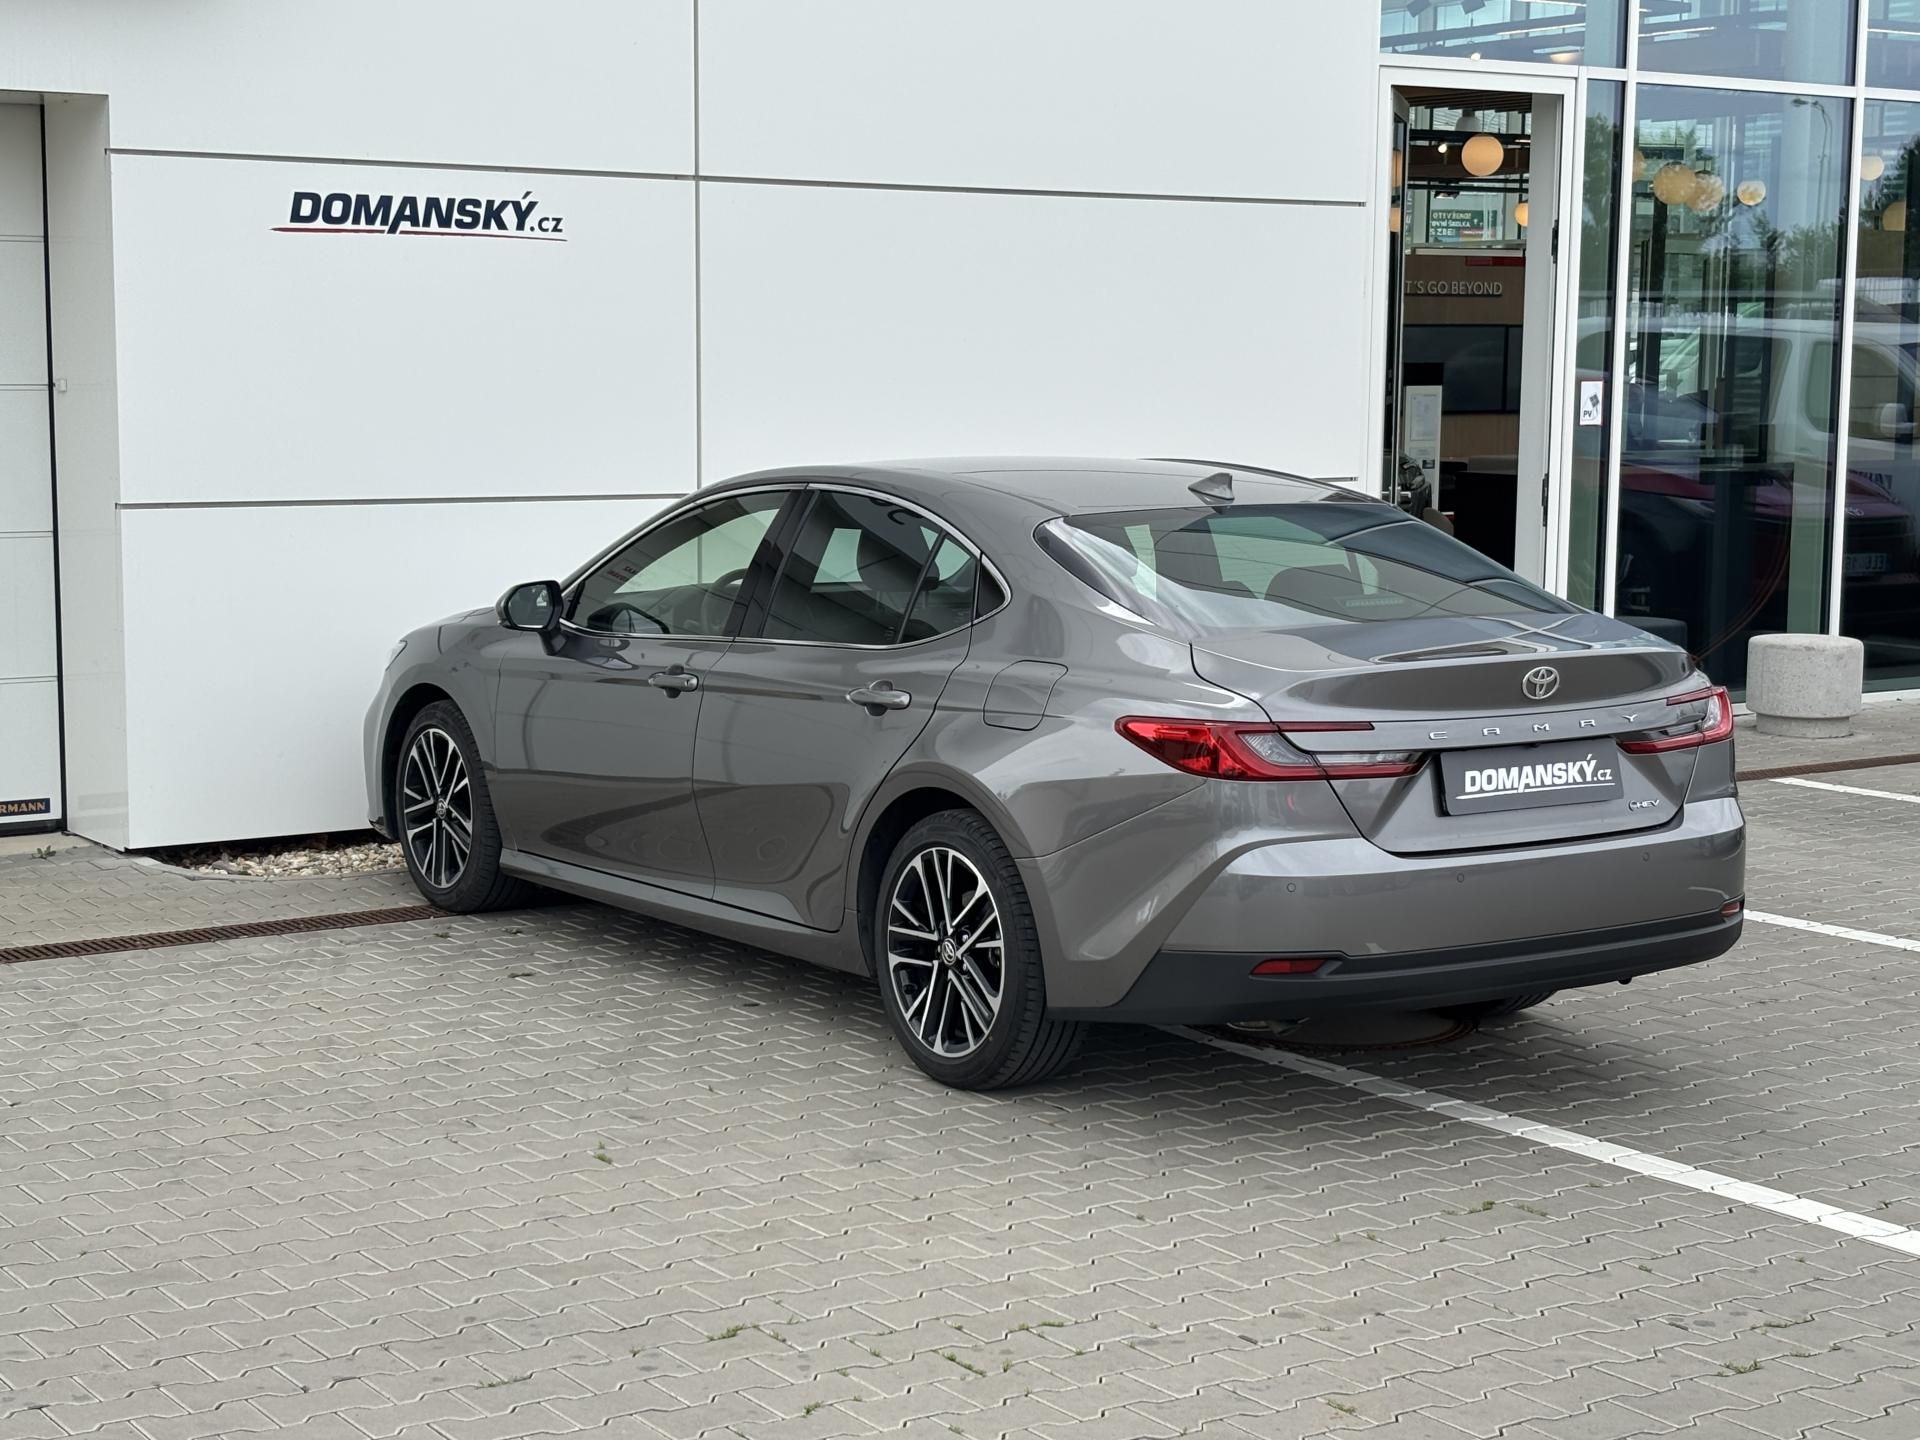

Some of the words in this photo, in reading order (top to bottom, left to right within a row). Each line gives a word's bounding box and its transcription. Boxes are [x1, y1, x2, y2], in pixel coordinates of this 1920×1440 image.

[289, 191, 564, 234] DOMANSKÝ.cz
[1427, 281, 1448, 294] GO
[1451, 281, 1503, 295] BEYOND
[1583, 410, 1592, 418] PV
[1429, 714, 1638, 739] CAMRY
[1464, 754, 1612, 793] DOMANSKÝ.cz
